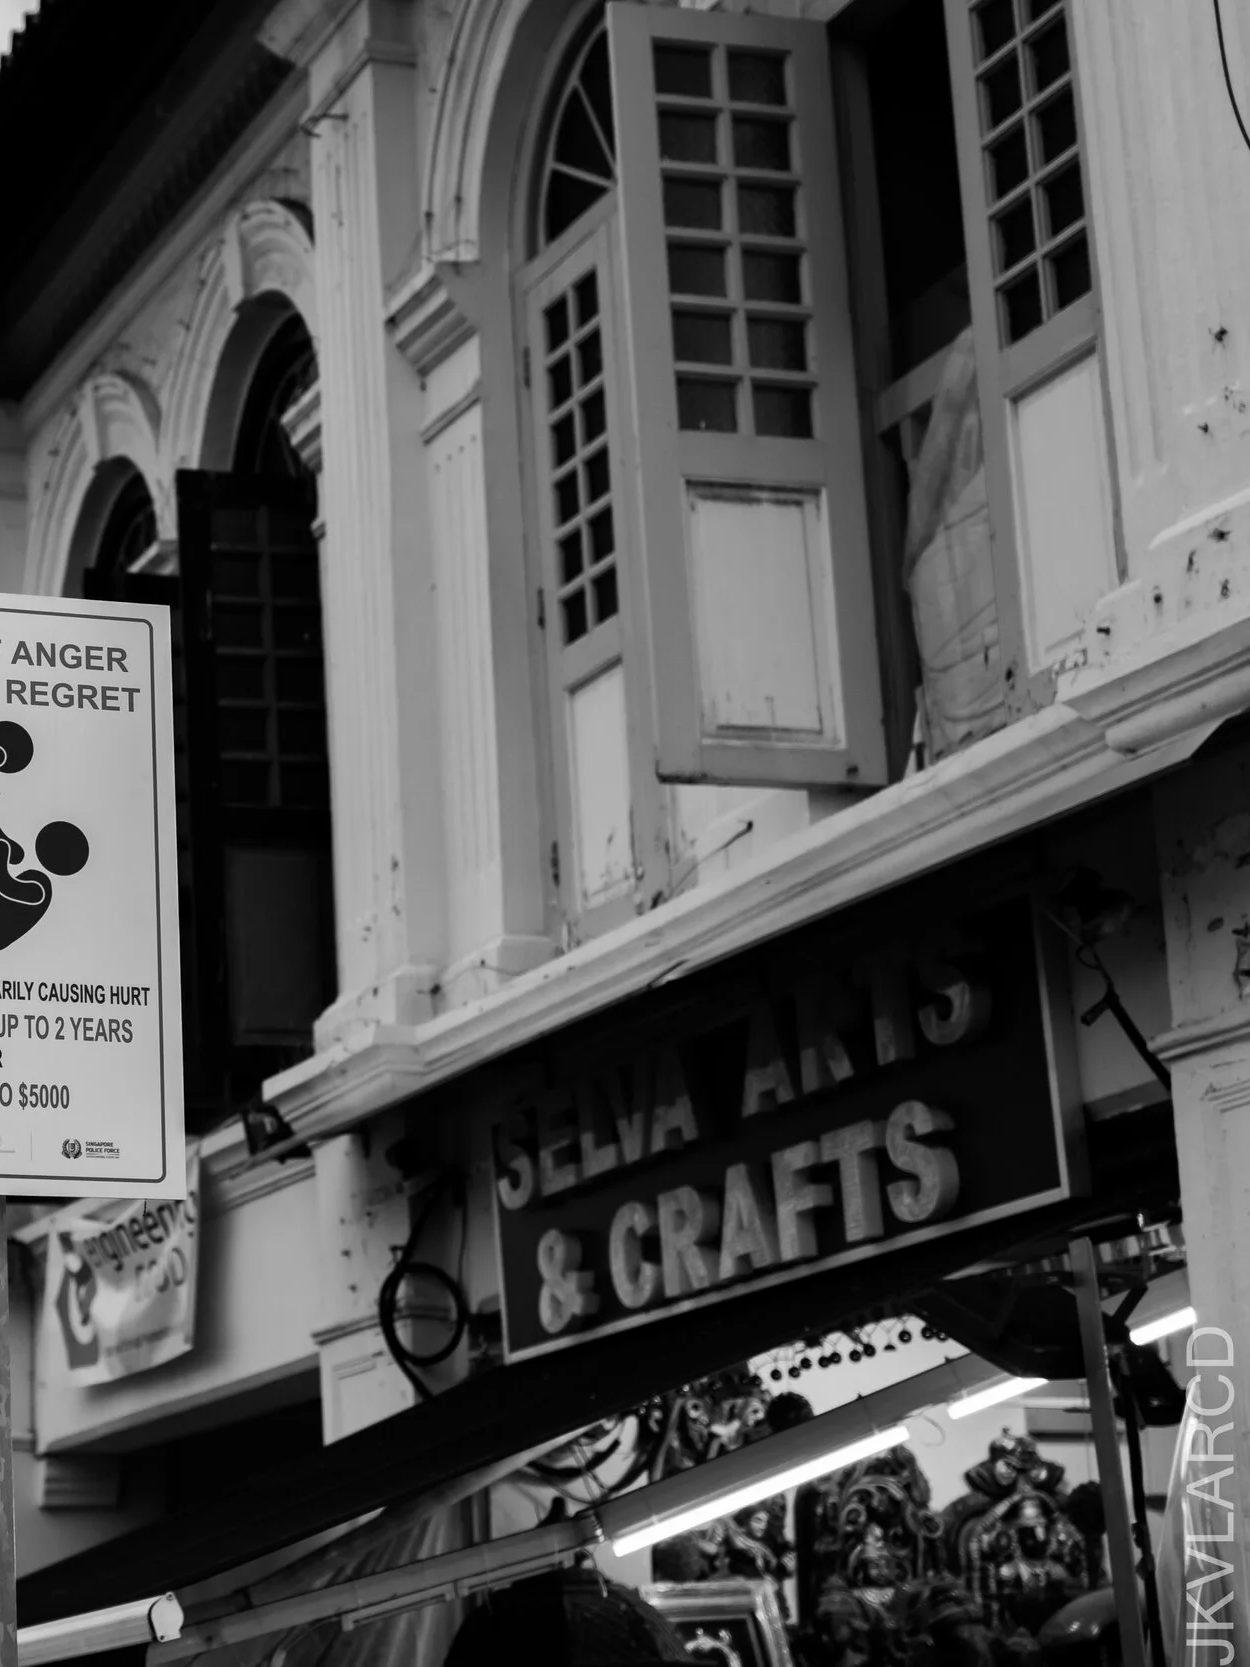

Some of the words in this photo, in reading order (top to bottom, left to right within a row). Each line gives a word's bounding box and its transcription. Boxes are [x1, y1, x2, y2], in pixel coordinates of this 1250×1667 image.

[11, 641, 129, 673] ANGER
[7, 680, 141, 713] REGRET
[39, 982, 106, 1005] CAUSING
[110, 986, 151, 1007] HURT
[25, 1015, 50, 1040] TO
[55, 1017, 65, 1041] 2
[70, 1017, 134, 1044] YEARS
[496, 1036, 699, 1210] SELVA
[740, 927, 990, 1118] ARTS
[19, 1082, 70, 1111] $5000
[538, 1226, 599, 1334] &
[609, 1100, 961, 1309] CRAFTS
